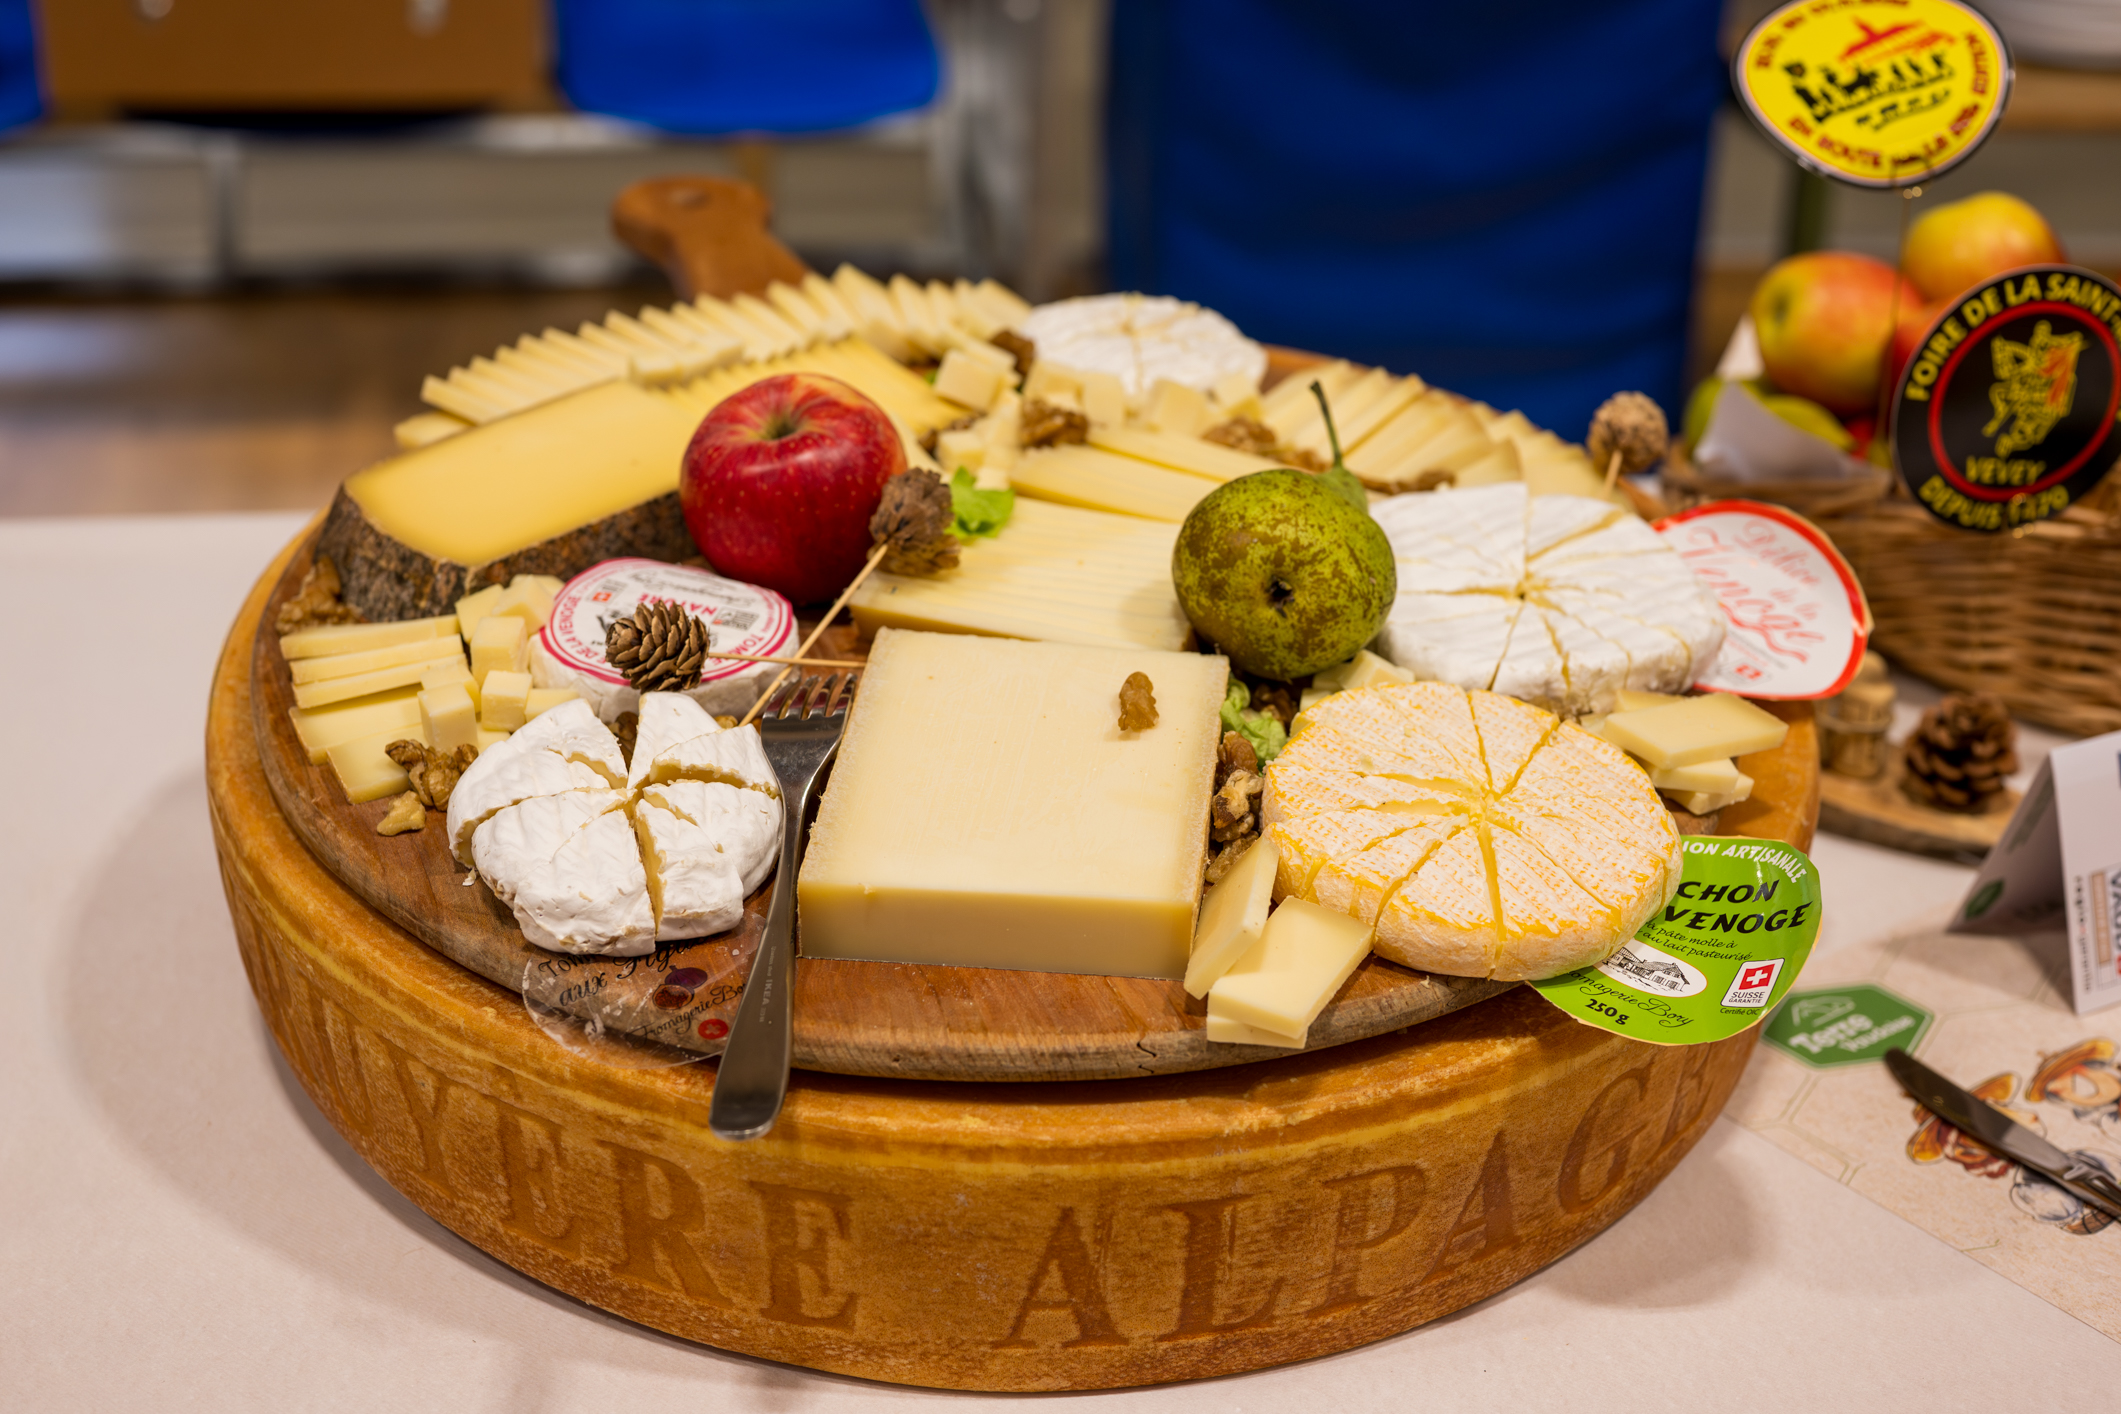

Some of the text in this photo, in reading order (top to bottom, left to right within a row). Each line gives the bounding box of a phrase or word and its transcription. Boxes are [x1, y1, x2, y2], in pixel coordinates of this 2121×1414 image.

[1905, 314, 1967, 402] FOIRE
[1960, 286, 2002, 328] DE
[2003, 273, 2043, 307] LA
[1682, 840, 1807, 884] ION ARTISANALE
[1675, 879, 1780, 903] CHON
[1664, 900, 1813, 934] VENOGE
[1655, 926, 1689, 942] pâte
[1688, 936, 1726, 949] molle
[1725, 940, 1738, 949] à
[1662, 938, 1691, 953] lait
[1685, 947, 1754, 961] pasteurisé
[559, 971, 609, 1008] aux
[762, 979, 773, 1005] IKEA
[1732, 991, 1766, 1000] SUISSE
[1584, 998, 1618, 1018] 250
[1637, 997, 1695, 1029] Bory
[993, 1062, 1714, 1350] ALPAGE
